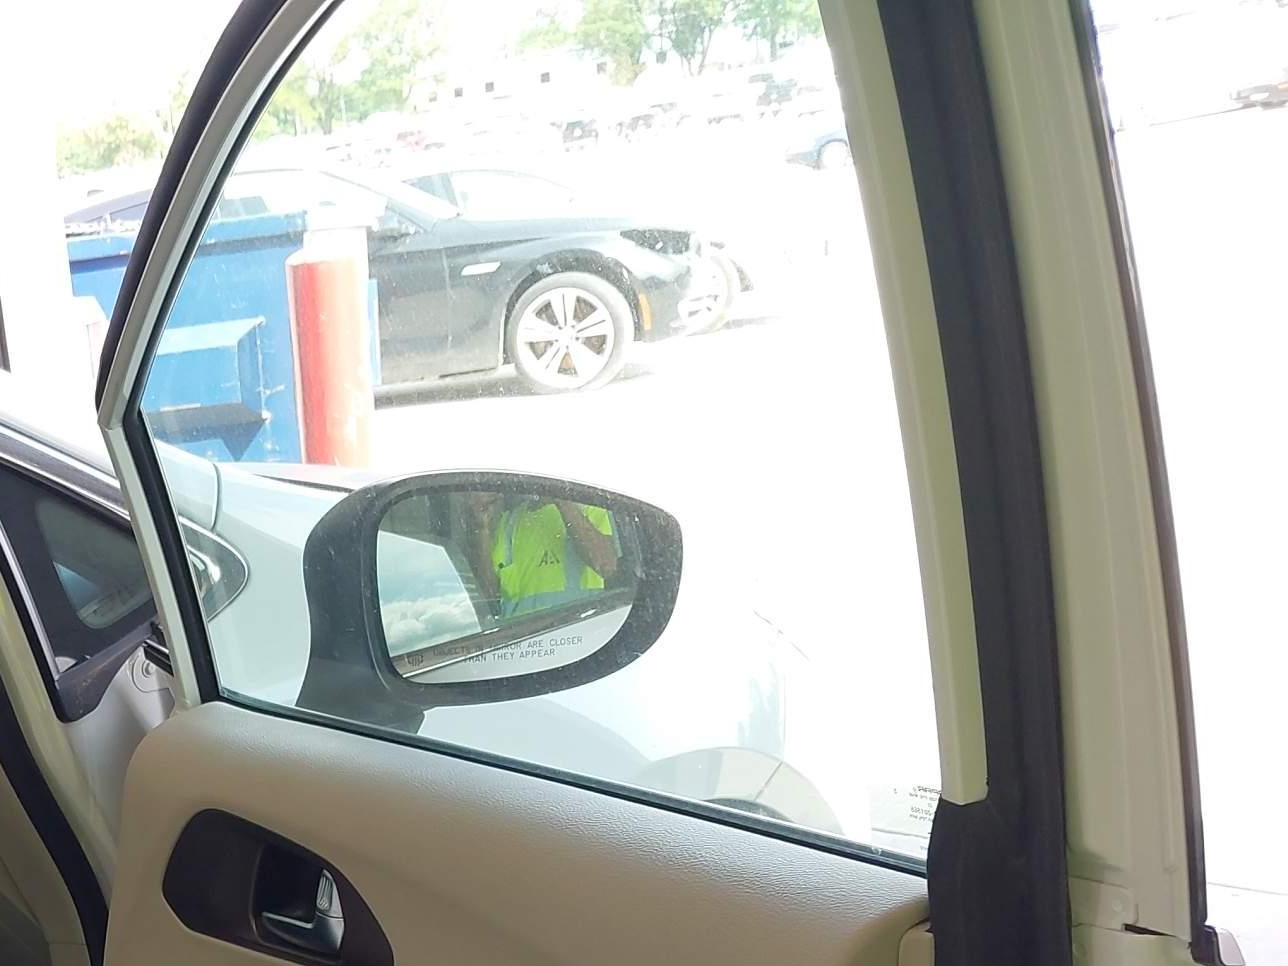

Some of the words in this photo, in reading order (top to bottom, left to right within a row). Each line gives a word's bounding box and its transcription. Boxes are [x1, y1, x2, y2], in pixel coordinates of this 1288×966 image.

[527, 639, 545, 648] ARE
[549, 635, 583, 647] CLOSER
[492, 651, 516, 661] THEY
[519, 647, 556, 658] APPEAR
